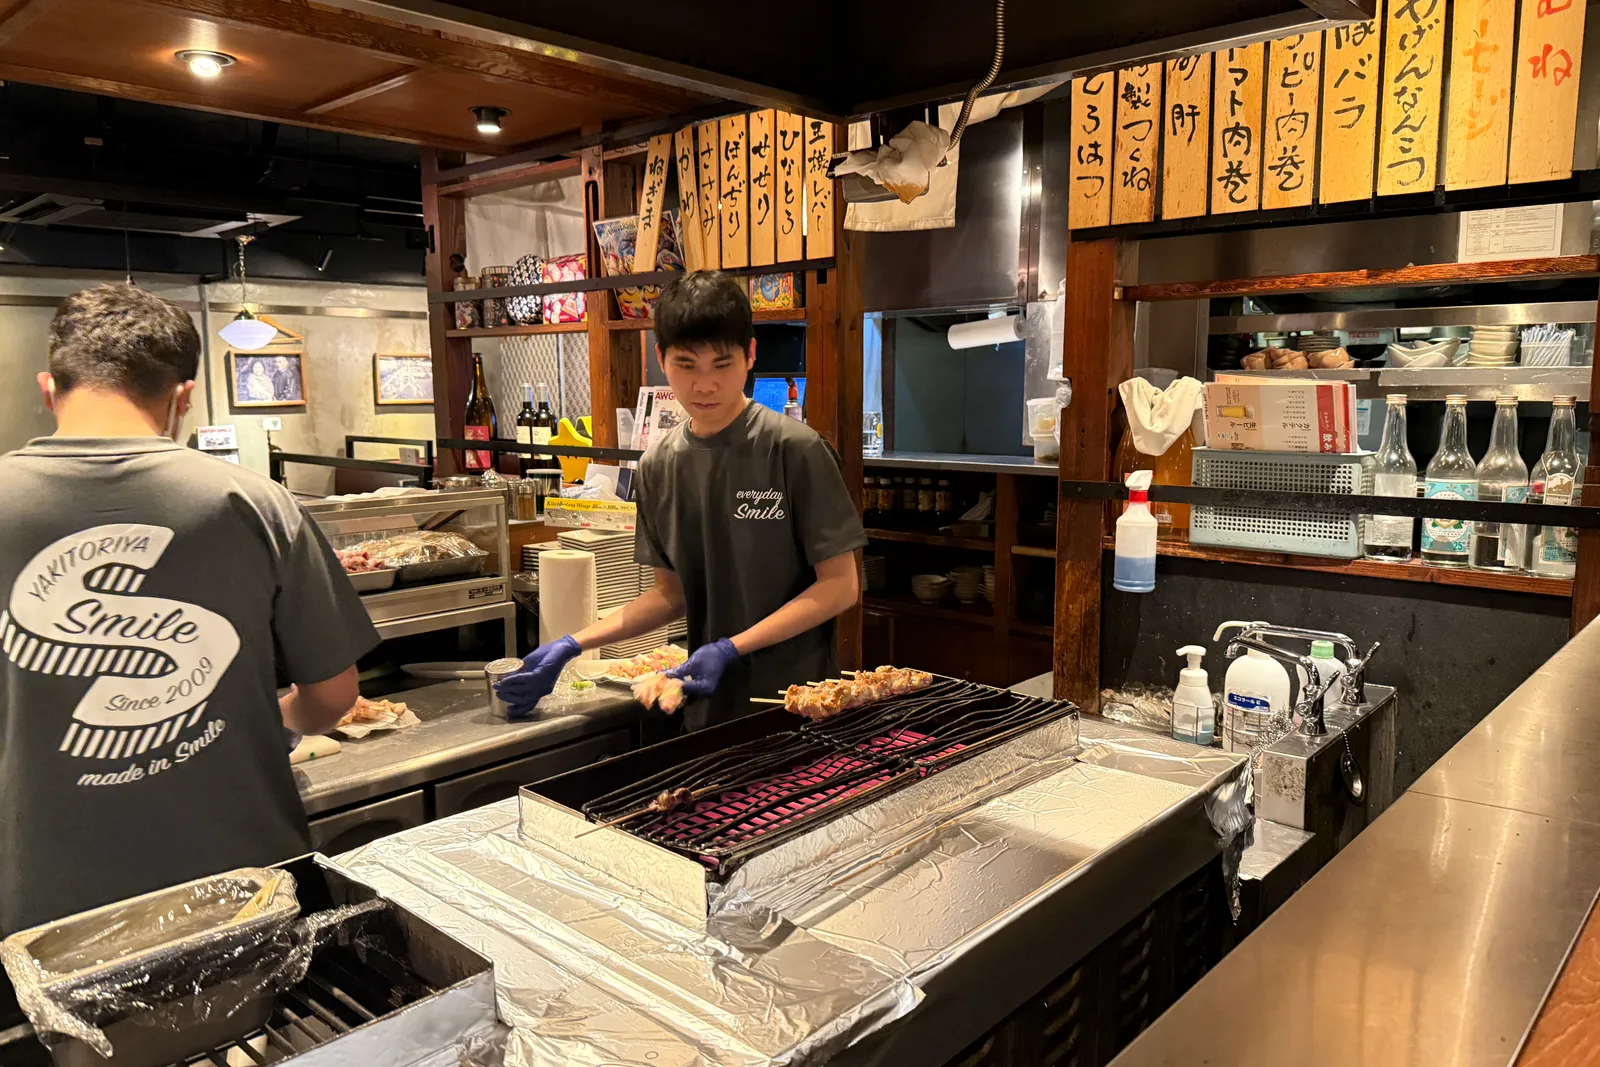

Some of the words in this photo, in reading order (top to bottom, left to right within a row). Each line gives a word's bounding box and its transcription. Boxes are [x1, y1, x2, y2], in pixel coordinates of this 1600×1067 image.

[1463, 0, 1506, 141] ーセージ
[1121, 65, 1153, 191] 製つくね
[641, 155, 665, 231] ねぎま
[678, 147, 695, 219] かわ
[700, 142, 716, 236] ささみ
[752, 134, 771, 225] せせり
[655, 391, 675, 400] AWG
[1323, 433, 1333, 452] 飲み
[733, 503, 785, 519] Smile
[736, 488, 783, 505] everyday
[28, 536, 150, 602] YAKITORIYA
[52, 598, 200, 644] Smile
[105, 694, 160, 711] Since
[166, 656, 214, 704] 2009
[77, 763, 146, 786] made
[148, 758, 172, 775] in
[175, 718, 227, 763] Smile
